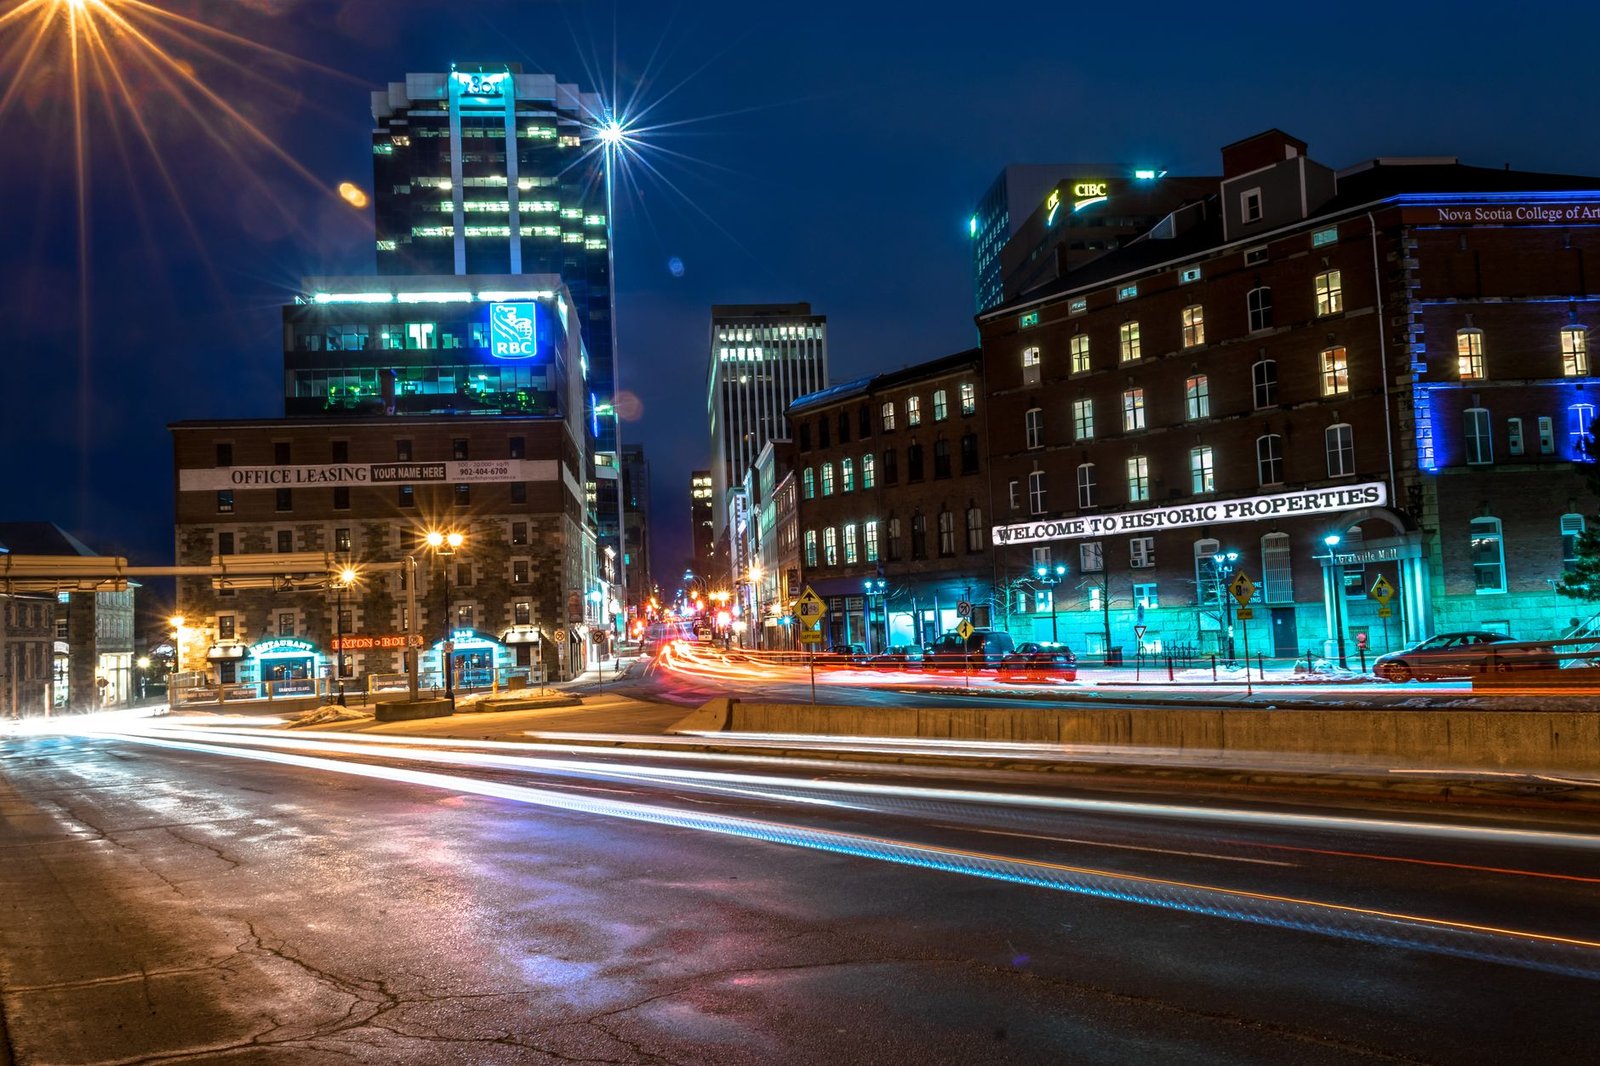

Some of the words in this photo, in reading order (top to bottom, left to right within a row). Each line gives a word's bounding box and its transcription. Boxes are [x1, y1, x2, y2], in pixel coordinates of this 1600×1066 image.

[1074, 183, 1107, 196] CIBC
[1437, 208, 1471, 221] Nova
[1475, 207, 1513, 220] Scotia
[1516, 206, 1562, 222] College
[1565, 206, 1580, 219] of
[496, 341, 532, 354] RBC
[231, 470, 292, 484] OFFICE
[296, 468, 367, 483] LEASING
[373, 468, 396, 479] YOUR
[398, 467, 421, 478] NAME
[422, 466, 444, 478] HERE
[460, 468, 508, 476] 902-404-6700
[997, 520, 1085, 542] WELCOME
[1090, 517, 1117, 532] TO
[1120, 506, 1217, 530] HISTORIC
[1224, 486, 1380, 519] PROPERTIES
